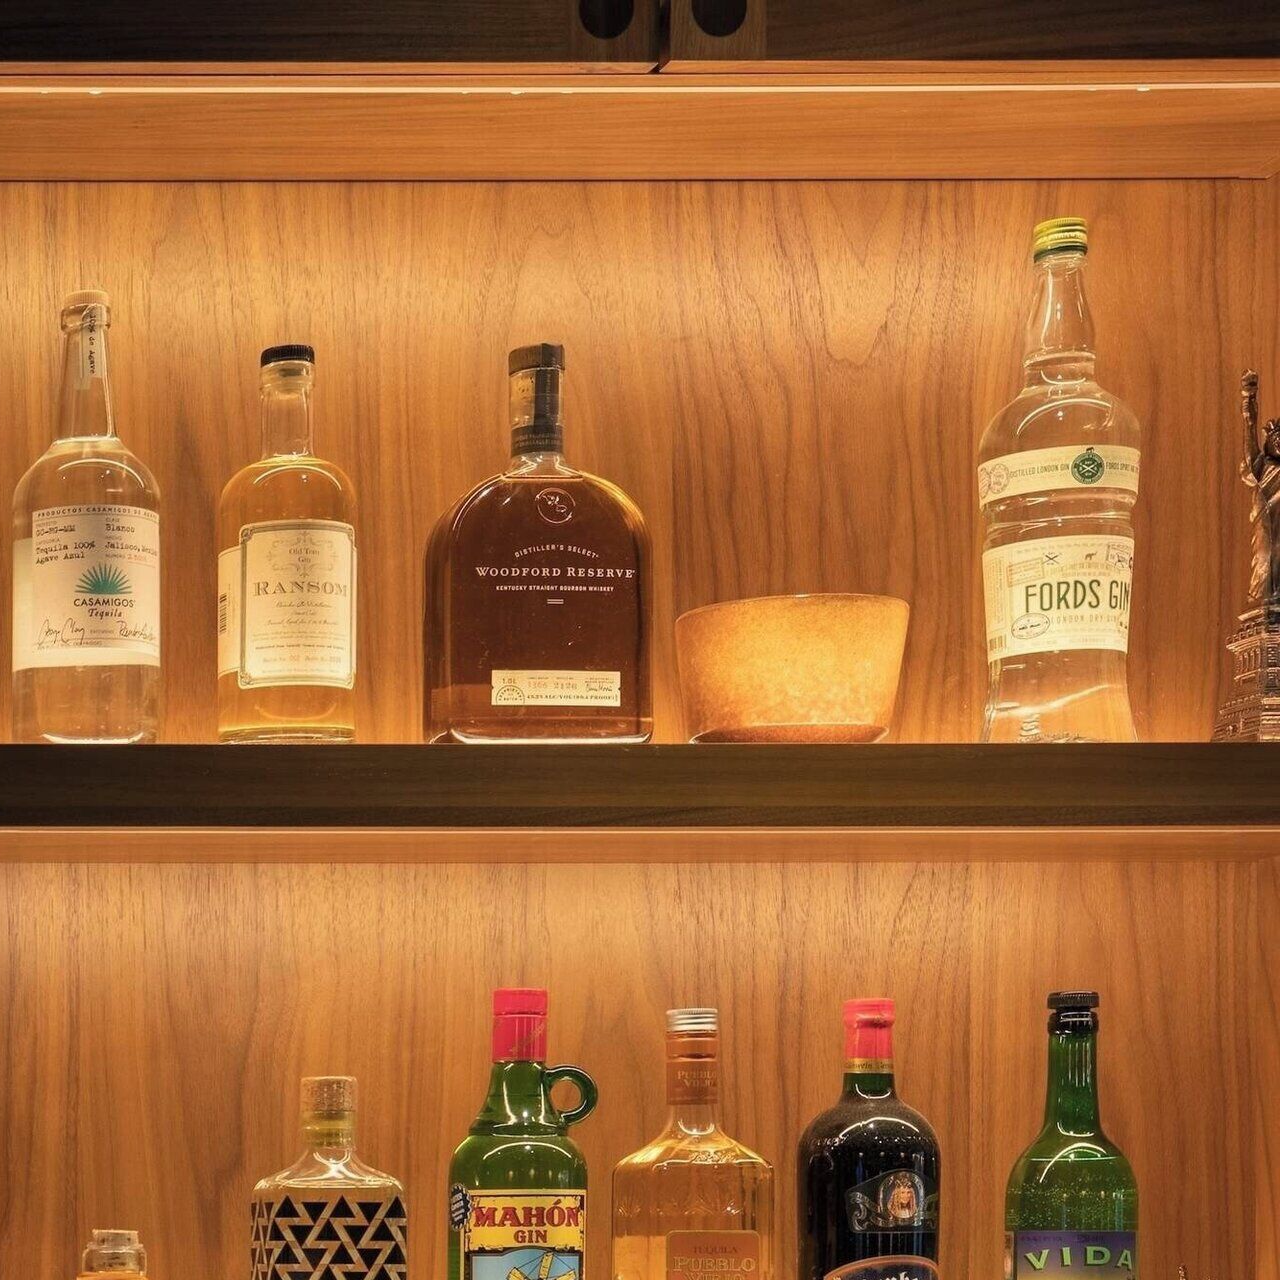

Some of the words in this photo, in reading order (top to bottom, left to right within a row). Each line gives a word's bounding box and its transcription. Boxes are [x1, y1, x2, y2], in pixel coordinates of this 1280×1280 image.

[476, 567, 561, 577] WOODFORD
[567, 567, 633, 578] RESERVE
[254, 581, 347, 597] RANSOM
[1025, 579, 1101, 613] FORDS
[1110, 579, 1130, 613] GIN
[74, 598, 133, 608] CASAMIGOS
[88, 608, 122, 618] Tequila
[473, 1199, 579, 1227] MAHÓN
[514, 1230, 547, 1243] GIN
[673, 1258, 755, 1272] PUEBLO
[1026, 1246, 1134, 1271] VIDA
